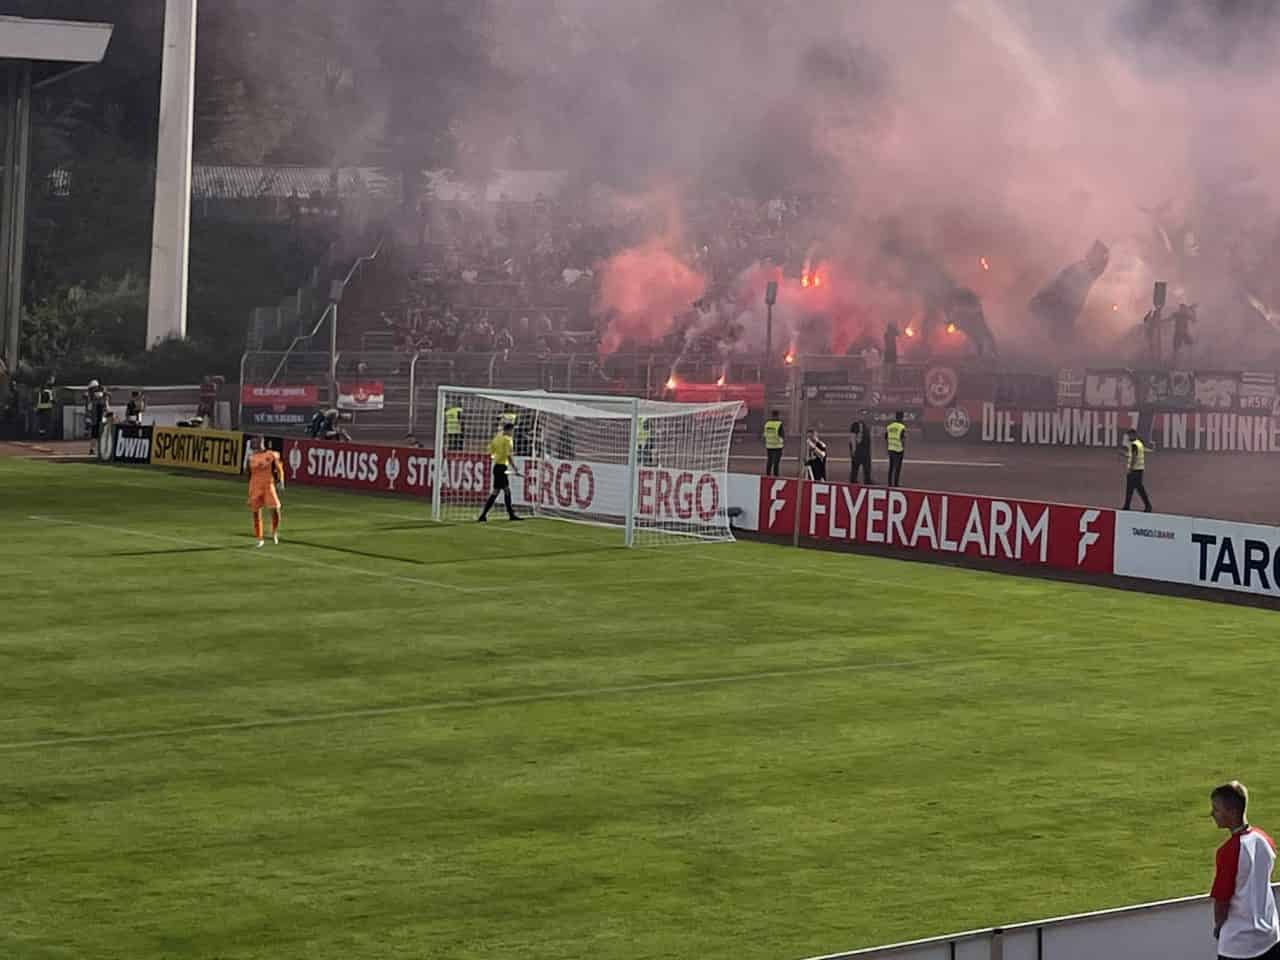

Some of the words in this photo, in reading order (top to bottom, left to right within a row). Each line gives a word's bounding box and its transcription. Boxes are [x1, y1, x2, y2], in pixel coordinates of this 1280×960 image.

[115, 430, 150, 458] bwin
[981, 401, 1017, 443] DIE
[1163, 413, 1187, 449] IN
[155, 432, 240, 467] SPORTWETTEN
[307, 447, 378, 482] STRAUSS
[523, 460, 595, 510] ERGO
[638, 469, 720, 520] ERGO
[808, 483, 1049, 562] FLYERALARM
